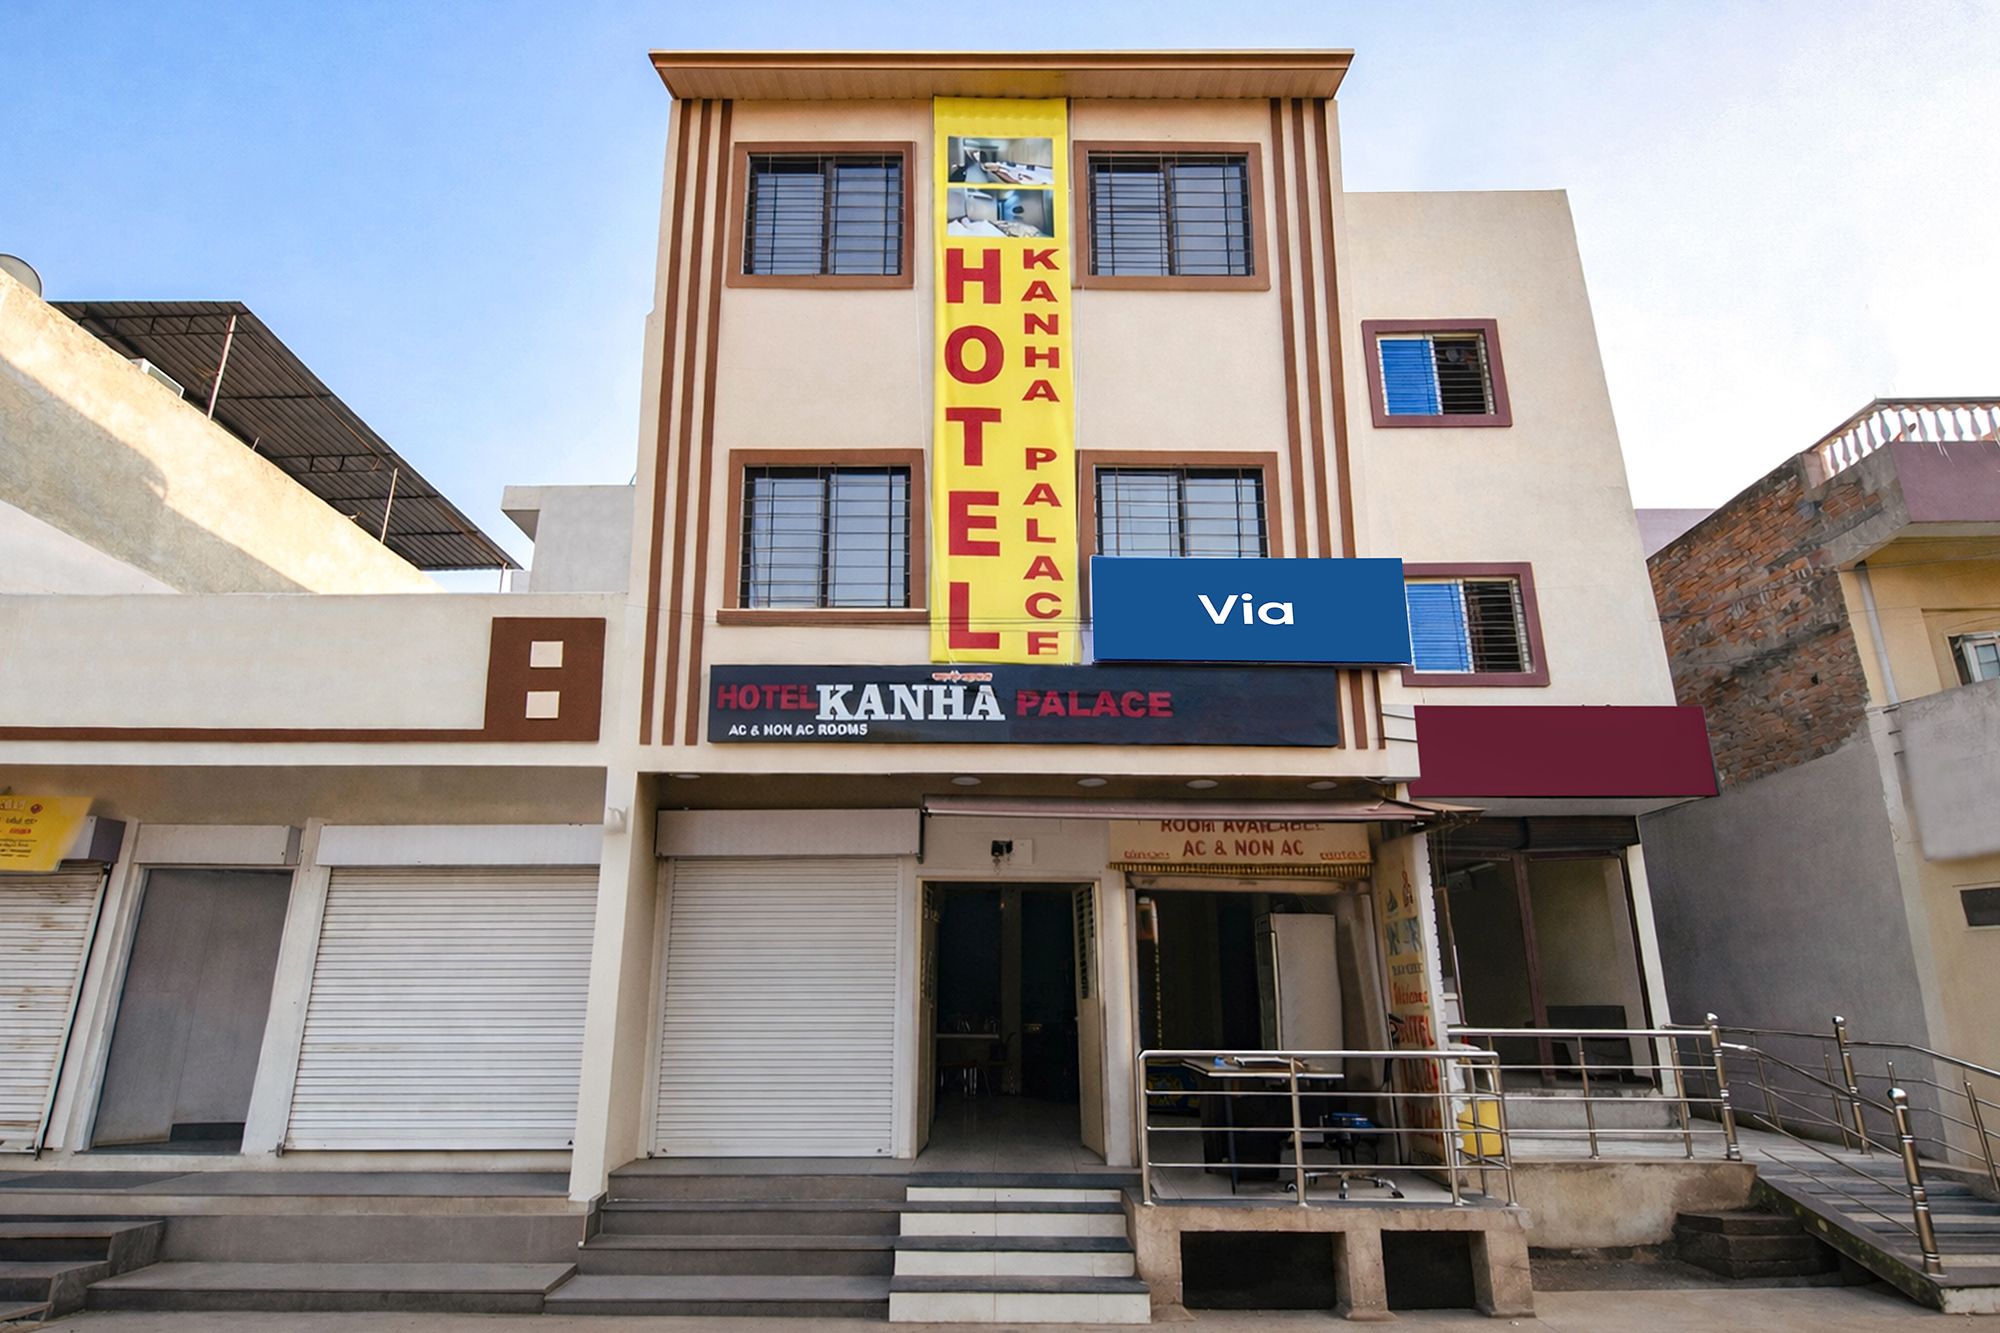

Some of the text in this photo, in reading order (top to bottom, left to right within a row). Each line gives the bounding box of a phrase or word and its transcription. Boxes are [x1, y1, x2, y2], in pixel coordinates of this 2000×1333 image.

[945, 247, 1005, 650] HOTEL
[1021, 247, 1064, 656] KANHA PALACE
[1197, 592, 1295, 626] Via
[716, 683, 1174, 722] HOTEL KANHA PALACE
[728, 722, 869, 736] AC & NON AC ROOMS
[1183, 840, 1207, 857] AC
[1214, 839, 1228, 856] &
[1234, 839, 1275, 857] NON
[1280, 839, 1304, 856] AC
